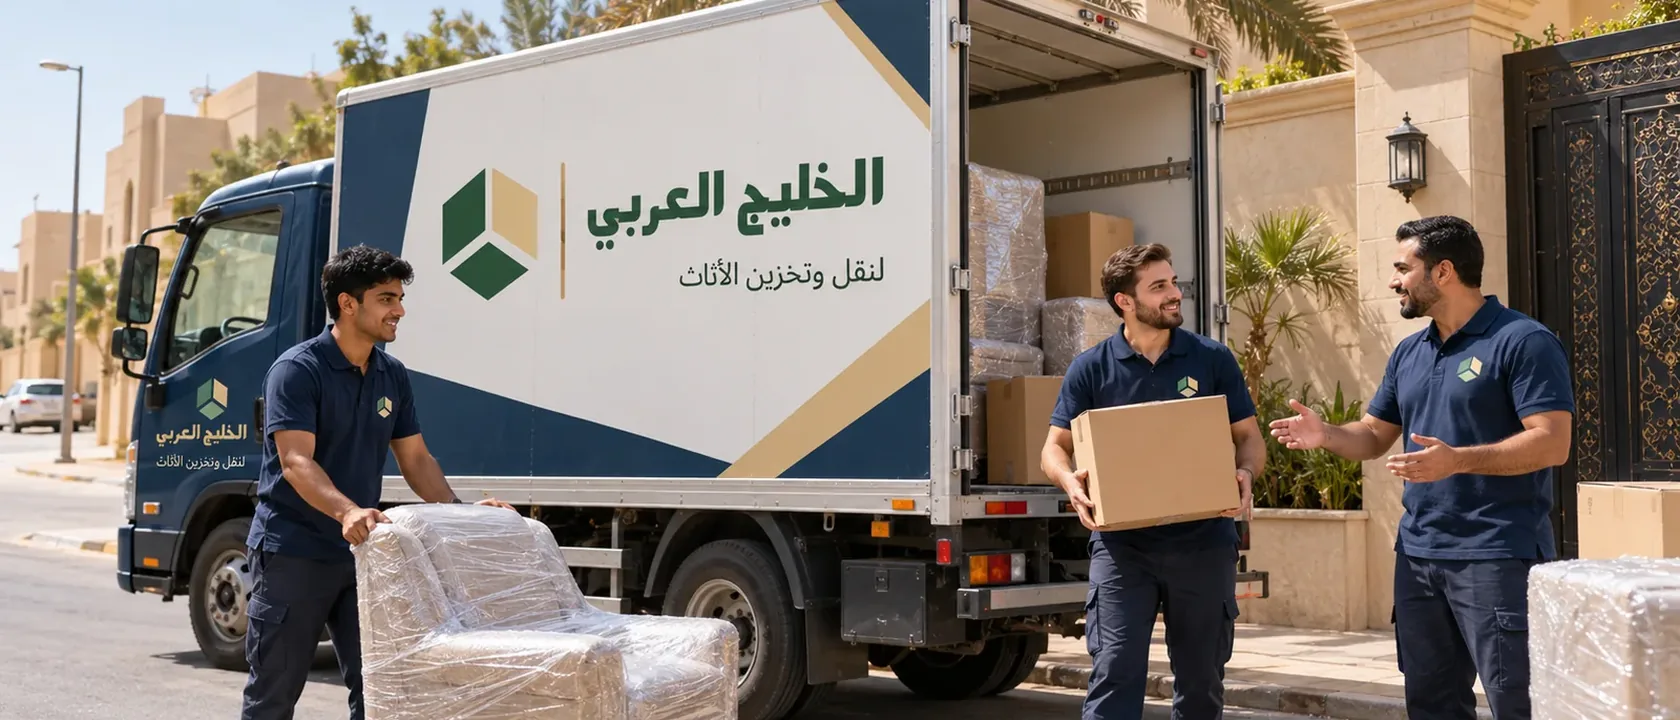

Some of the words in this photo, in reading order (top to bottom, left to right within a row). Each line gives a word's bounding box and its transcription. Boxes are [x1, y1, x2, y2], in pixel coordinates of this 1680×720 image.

[738, 156, 883, 236] الخليج
[588, 170, 724, 250] العربي
[680, 258, 737, 287] الأثاث
[746, 263, 824, 291] وتخزين
[832, 257, 883, 289] لنقل
[157, 424, 200, 446] العربي
[203, 424, 247, 445] الخليج
[156, 454, 183, 466] الأثاث
[186, 457, 220, 470] وتخزين
[222, 456, 245, 470] لنقل
